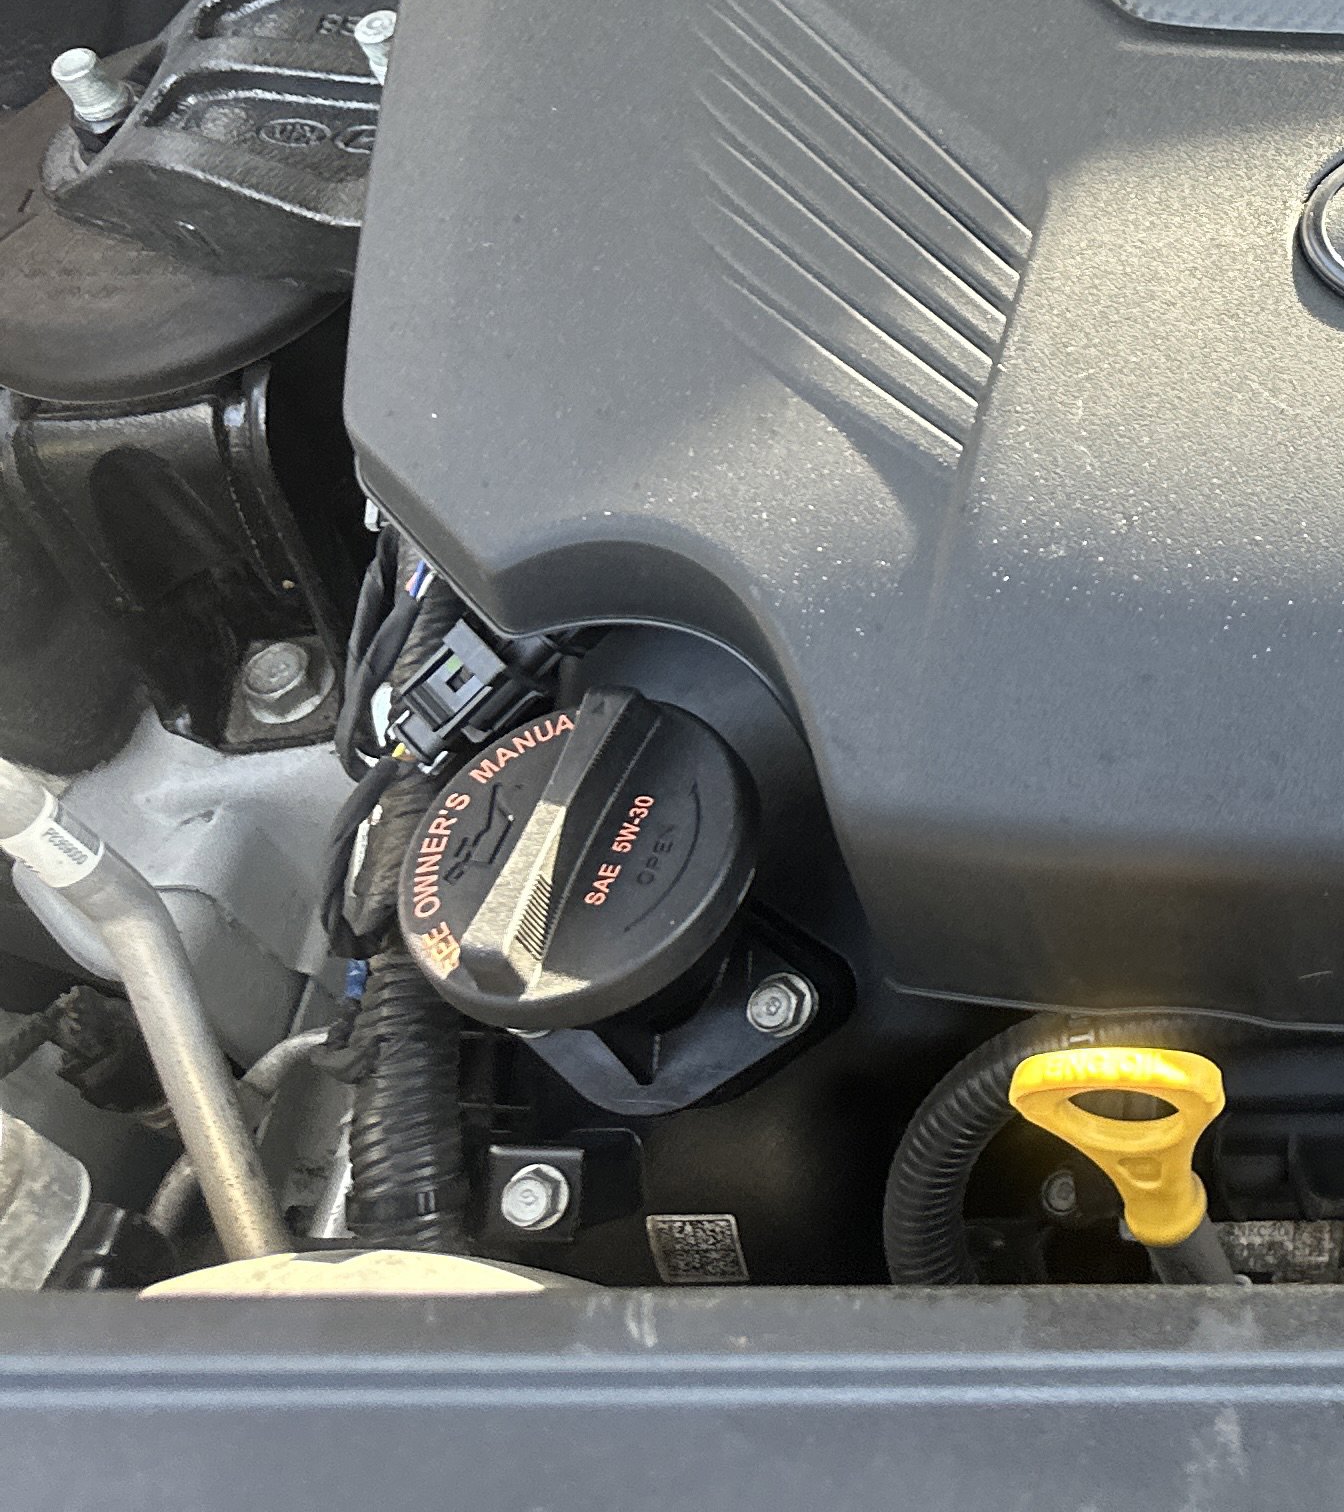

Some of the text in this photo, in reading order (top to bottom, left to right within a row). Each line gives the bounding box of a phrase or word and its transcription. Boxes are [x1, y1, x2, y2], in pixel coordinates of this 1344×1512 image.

[412, 792, 471, 919] OWNER'S
[468, 710, 581, 784] MANUA
[584, 795, 655, 906] SAE 5W-30
